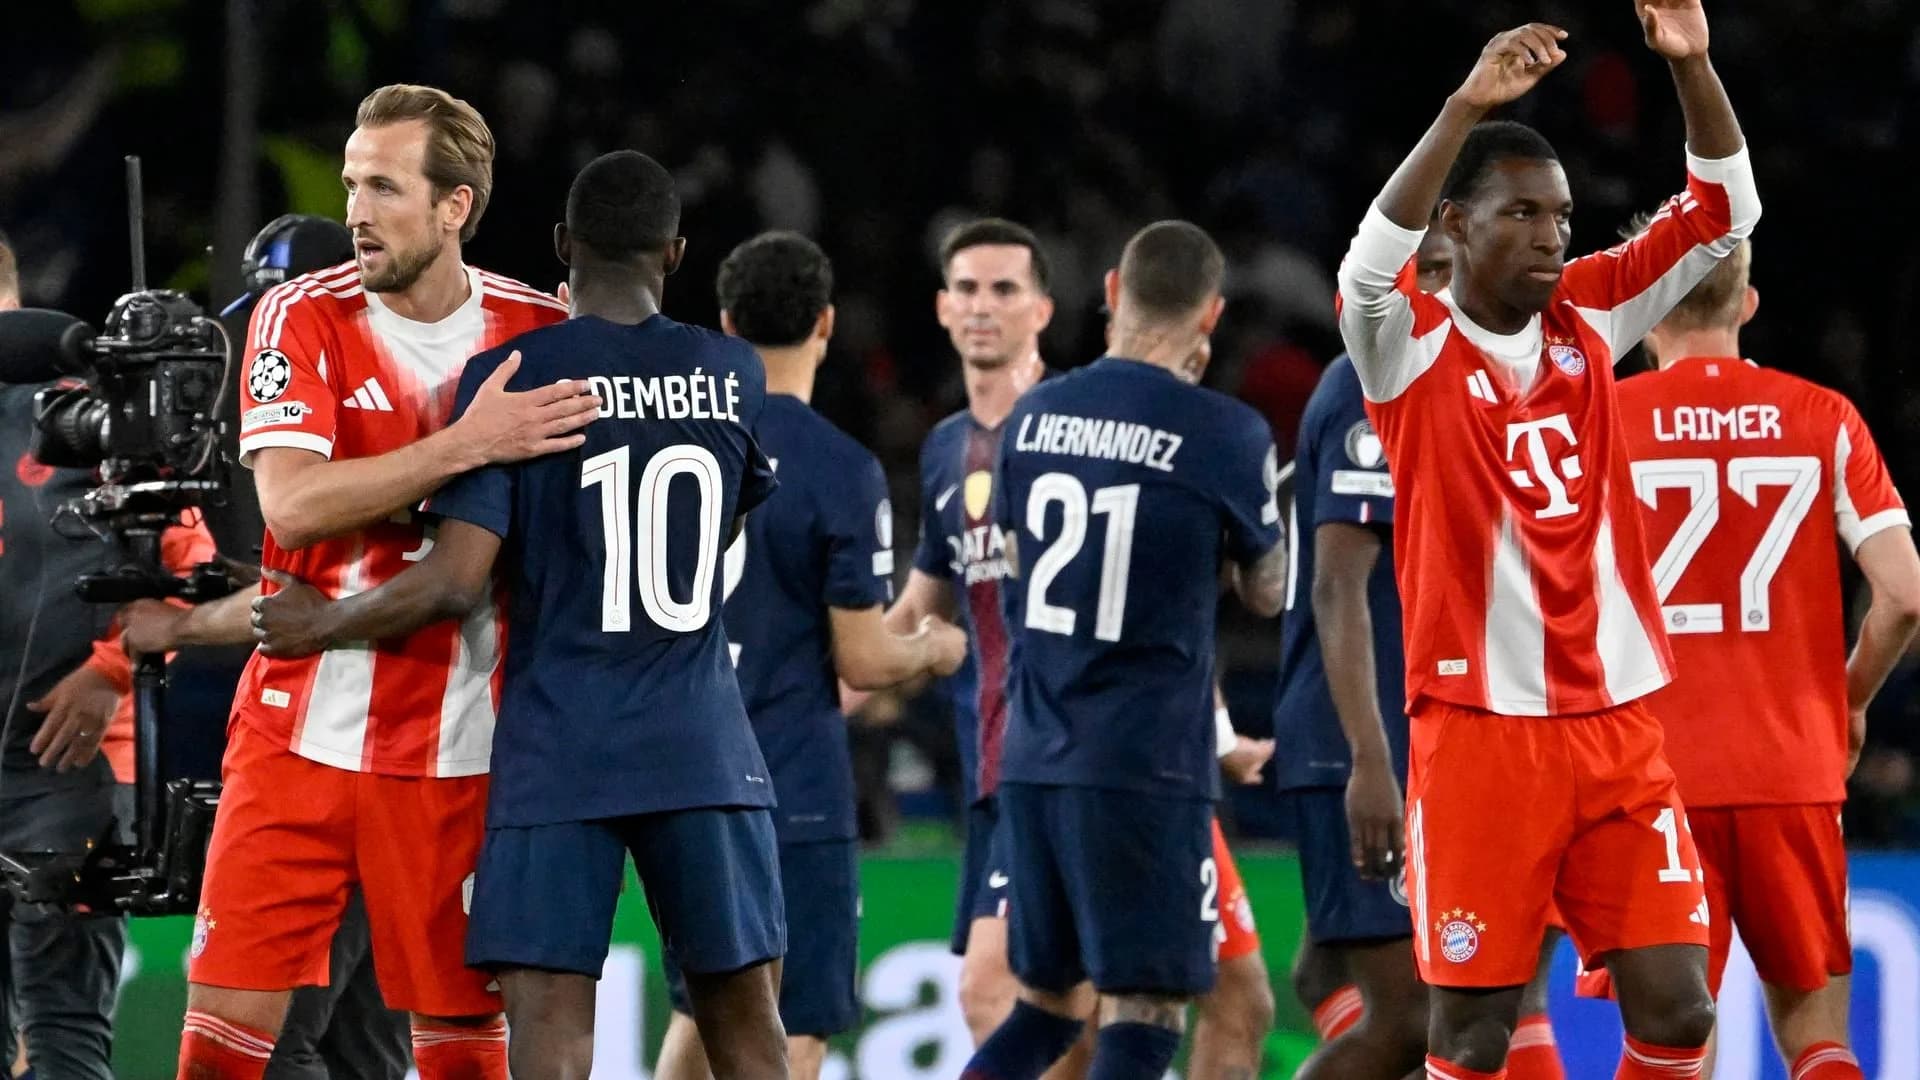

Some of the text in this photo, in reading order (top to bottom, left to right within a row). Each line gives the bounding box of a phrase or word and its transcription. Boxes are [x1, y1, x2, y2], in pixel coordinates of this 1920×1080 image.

[556, 367, 740, 424] DEMBÉLÉ
[1653, 405, 1782, 442] LAIMER
[1016, 413, 1184, 473] L.HERNANDEZ
[580, 444, 724, 633] 10
[1025, 471, 1141, 643] 21
[1630, 456, 1822, 634] 27
[1651, 807, 1704, 882] 1
